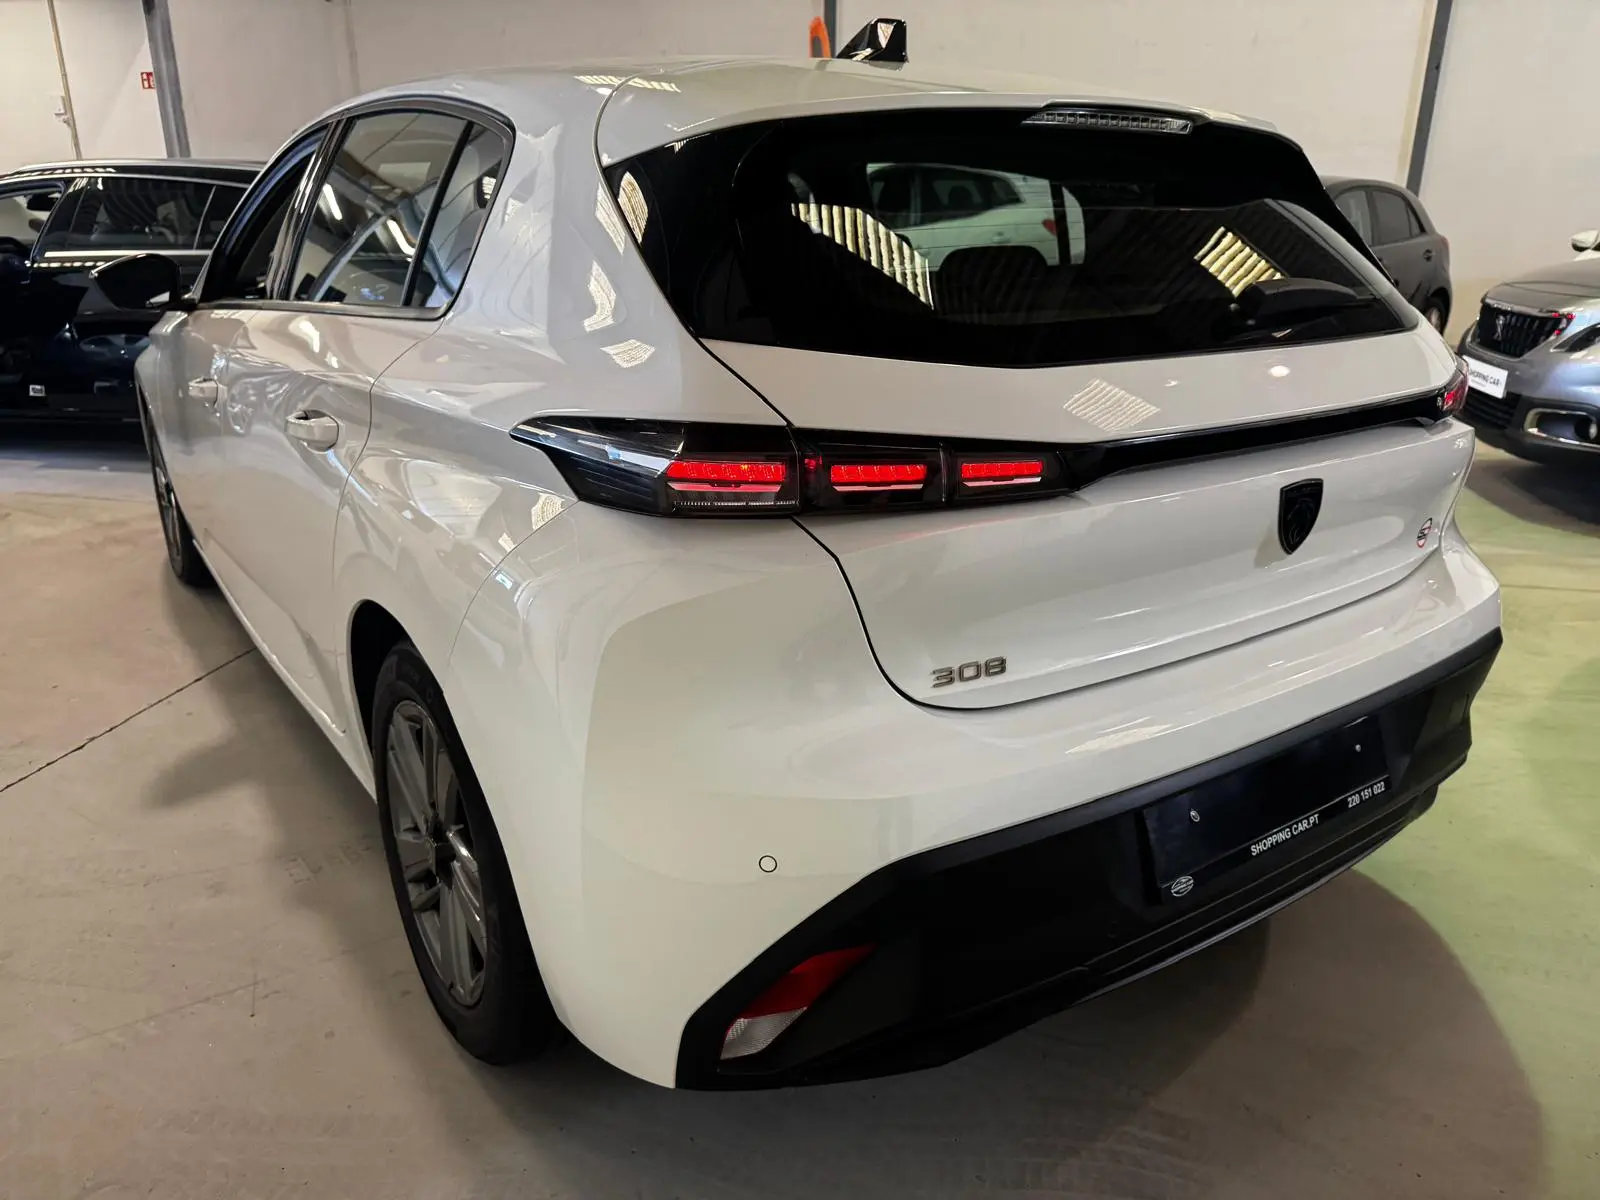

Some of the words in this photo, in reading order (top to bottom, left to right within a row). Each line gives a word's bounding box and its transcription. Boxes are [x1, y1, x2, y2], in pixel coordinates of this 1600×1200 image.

[930, 656, 1006, 688] 308
[1250, 828, 1291, 856] SHOPPING
[1291, 813, 1319, 835] CAR.PT
[1347, 793, 1360, 808] 220
[1361, 787, 1372, 800] 151
[1373, 781, 1385, 795] 022
